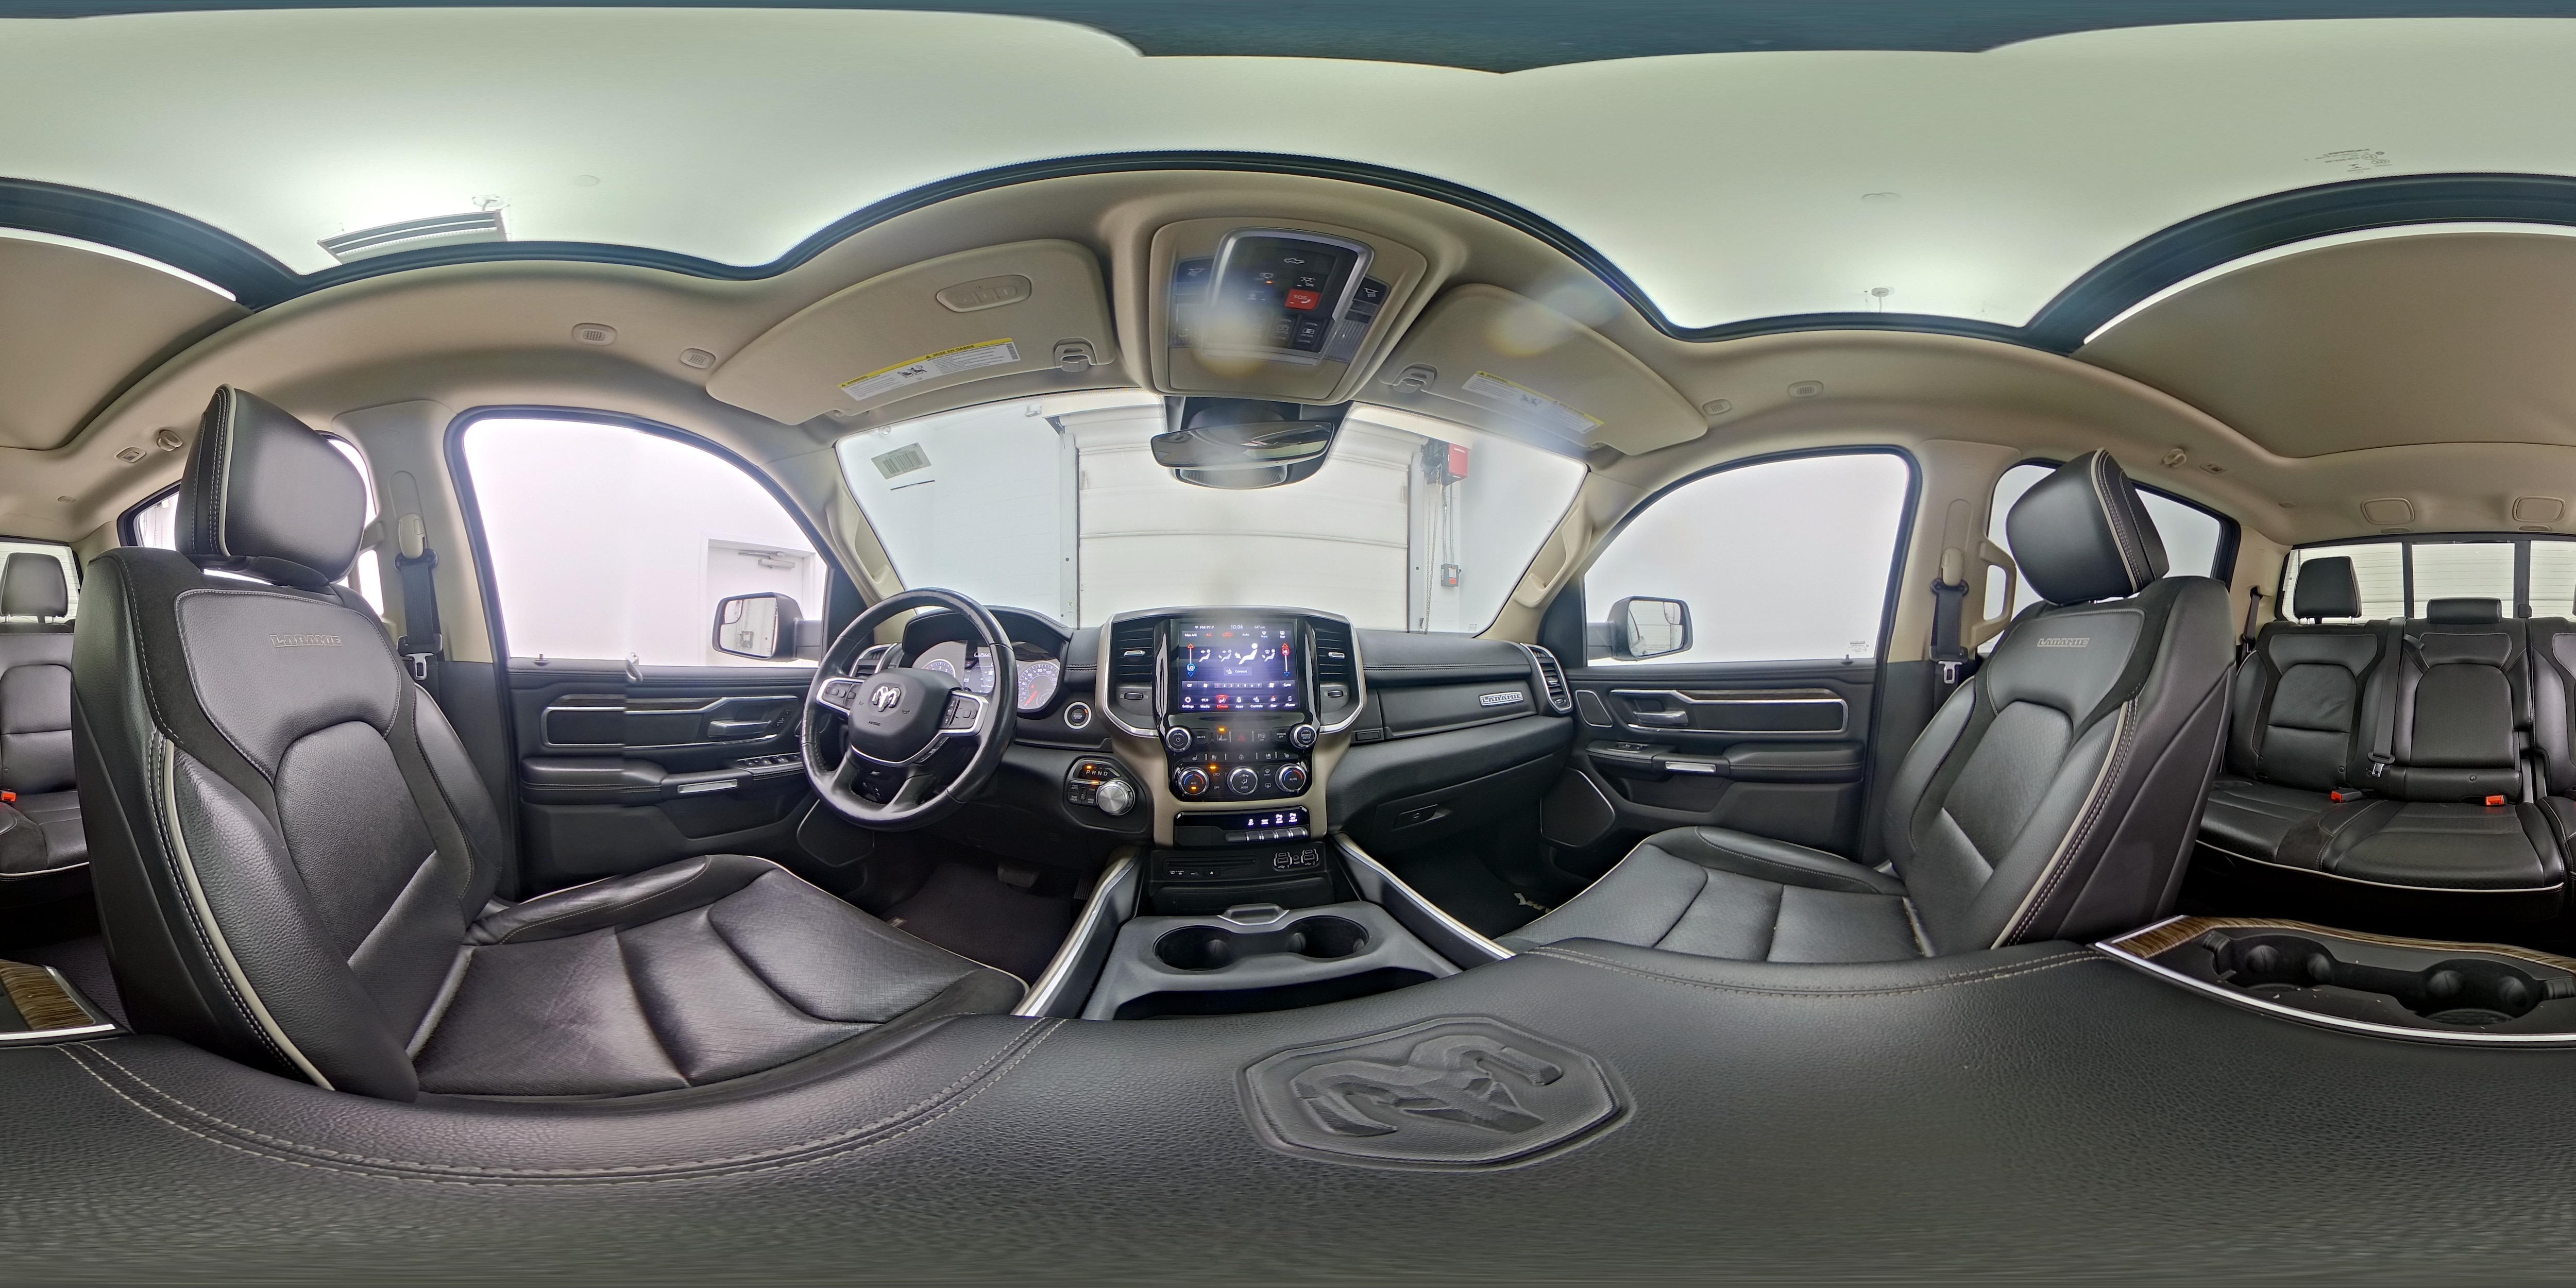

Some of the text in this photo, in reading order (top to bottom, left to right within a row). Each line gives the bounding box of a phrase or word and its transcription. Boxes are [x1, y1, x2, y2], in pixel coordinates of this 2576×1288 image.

[270, 634, 342, 648] LARAMIE
[2037, 637, 2090, 648] LARAMIE
[1482, 692, 1522, 704] LARAMIE
